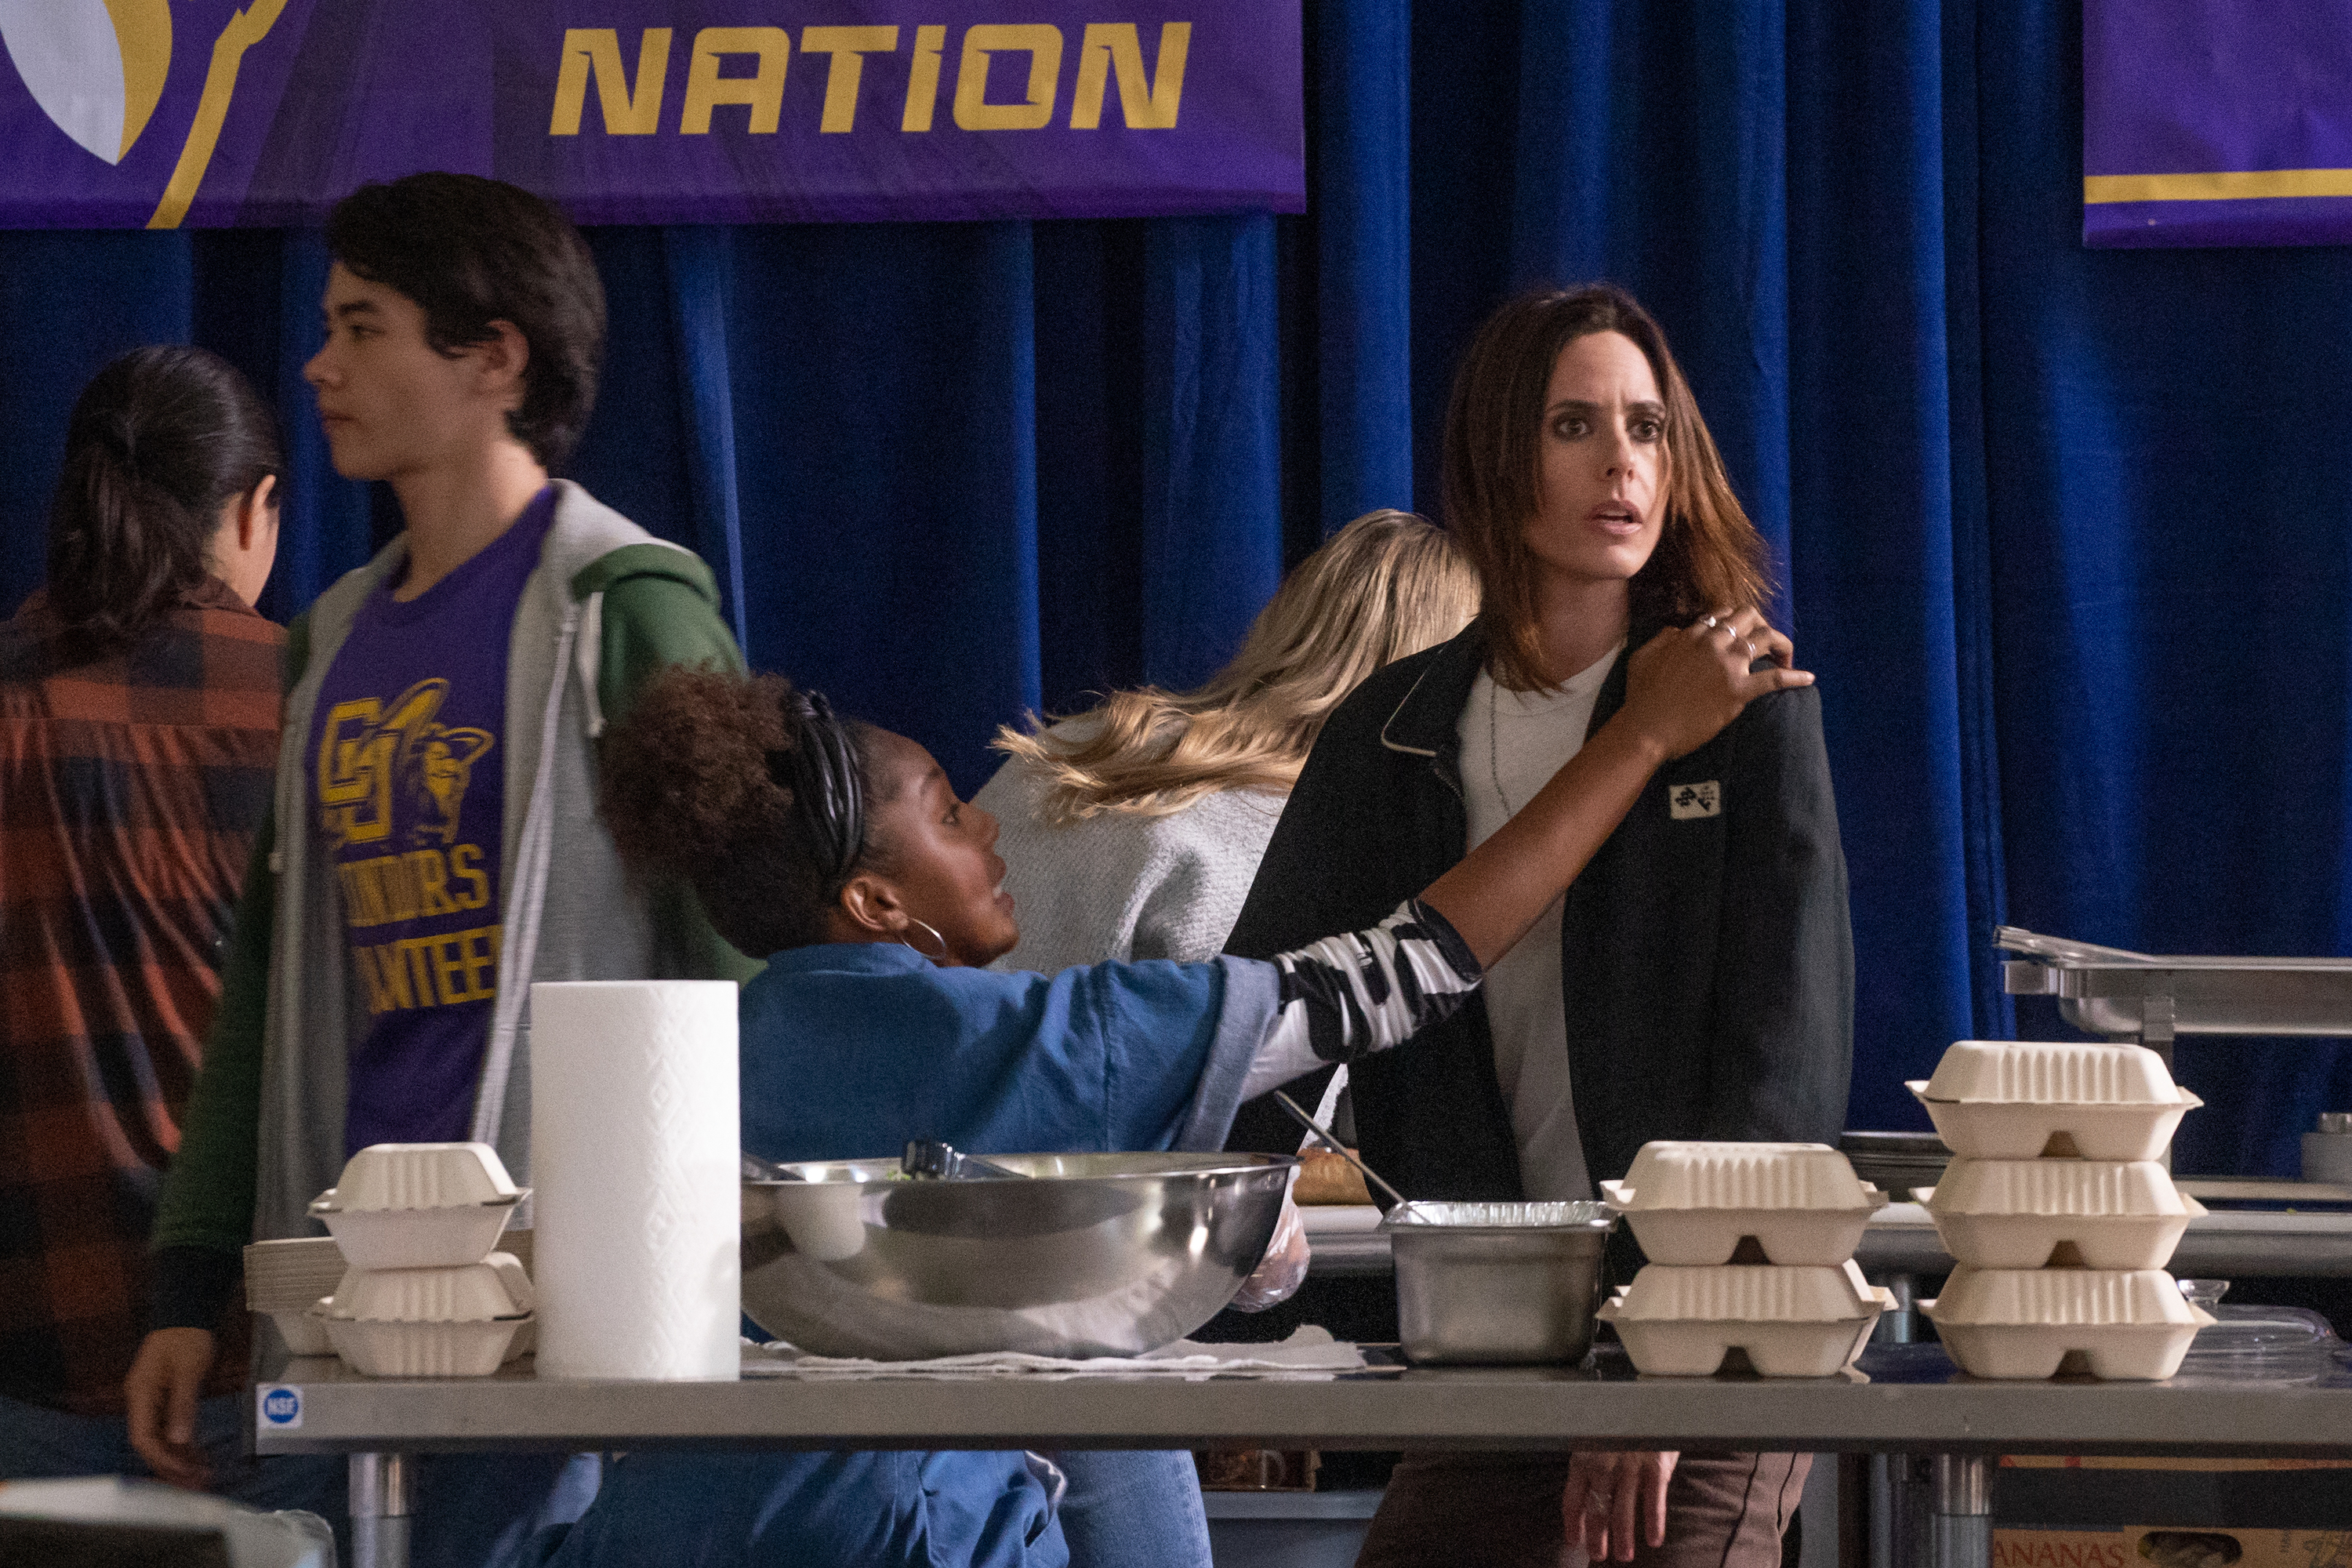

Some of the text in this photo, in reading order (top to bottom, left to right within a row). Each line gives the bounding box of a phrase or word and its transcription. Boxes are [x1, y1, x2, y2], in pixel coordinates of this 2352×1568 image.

[550, 22, 1192, 136] NATION
[267, 1397, 296, 1415] NSF
[1993, 1541, 2125, 1568] ANANAS
